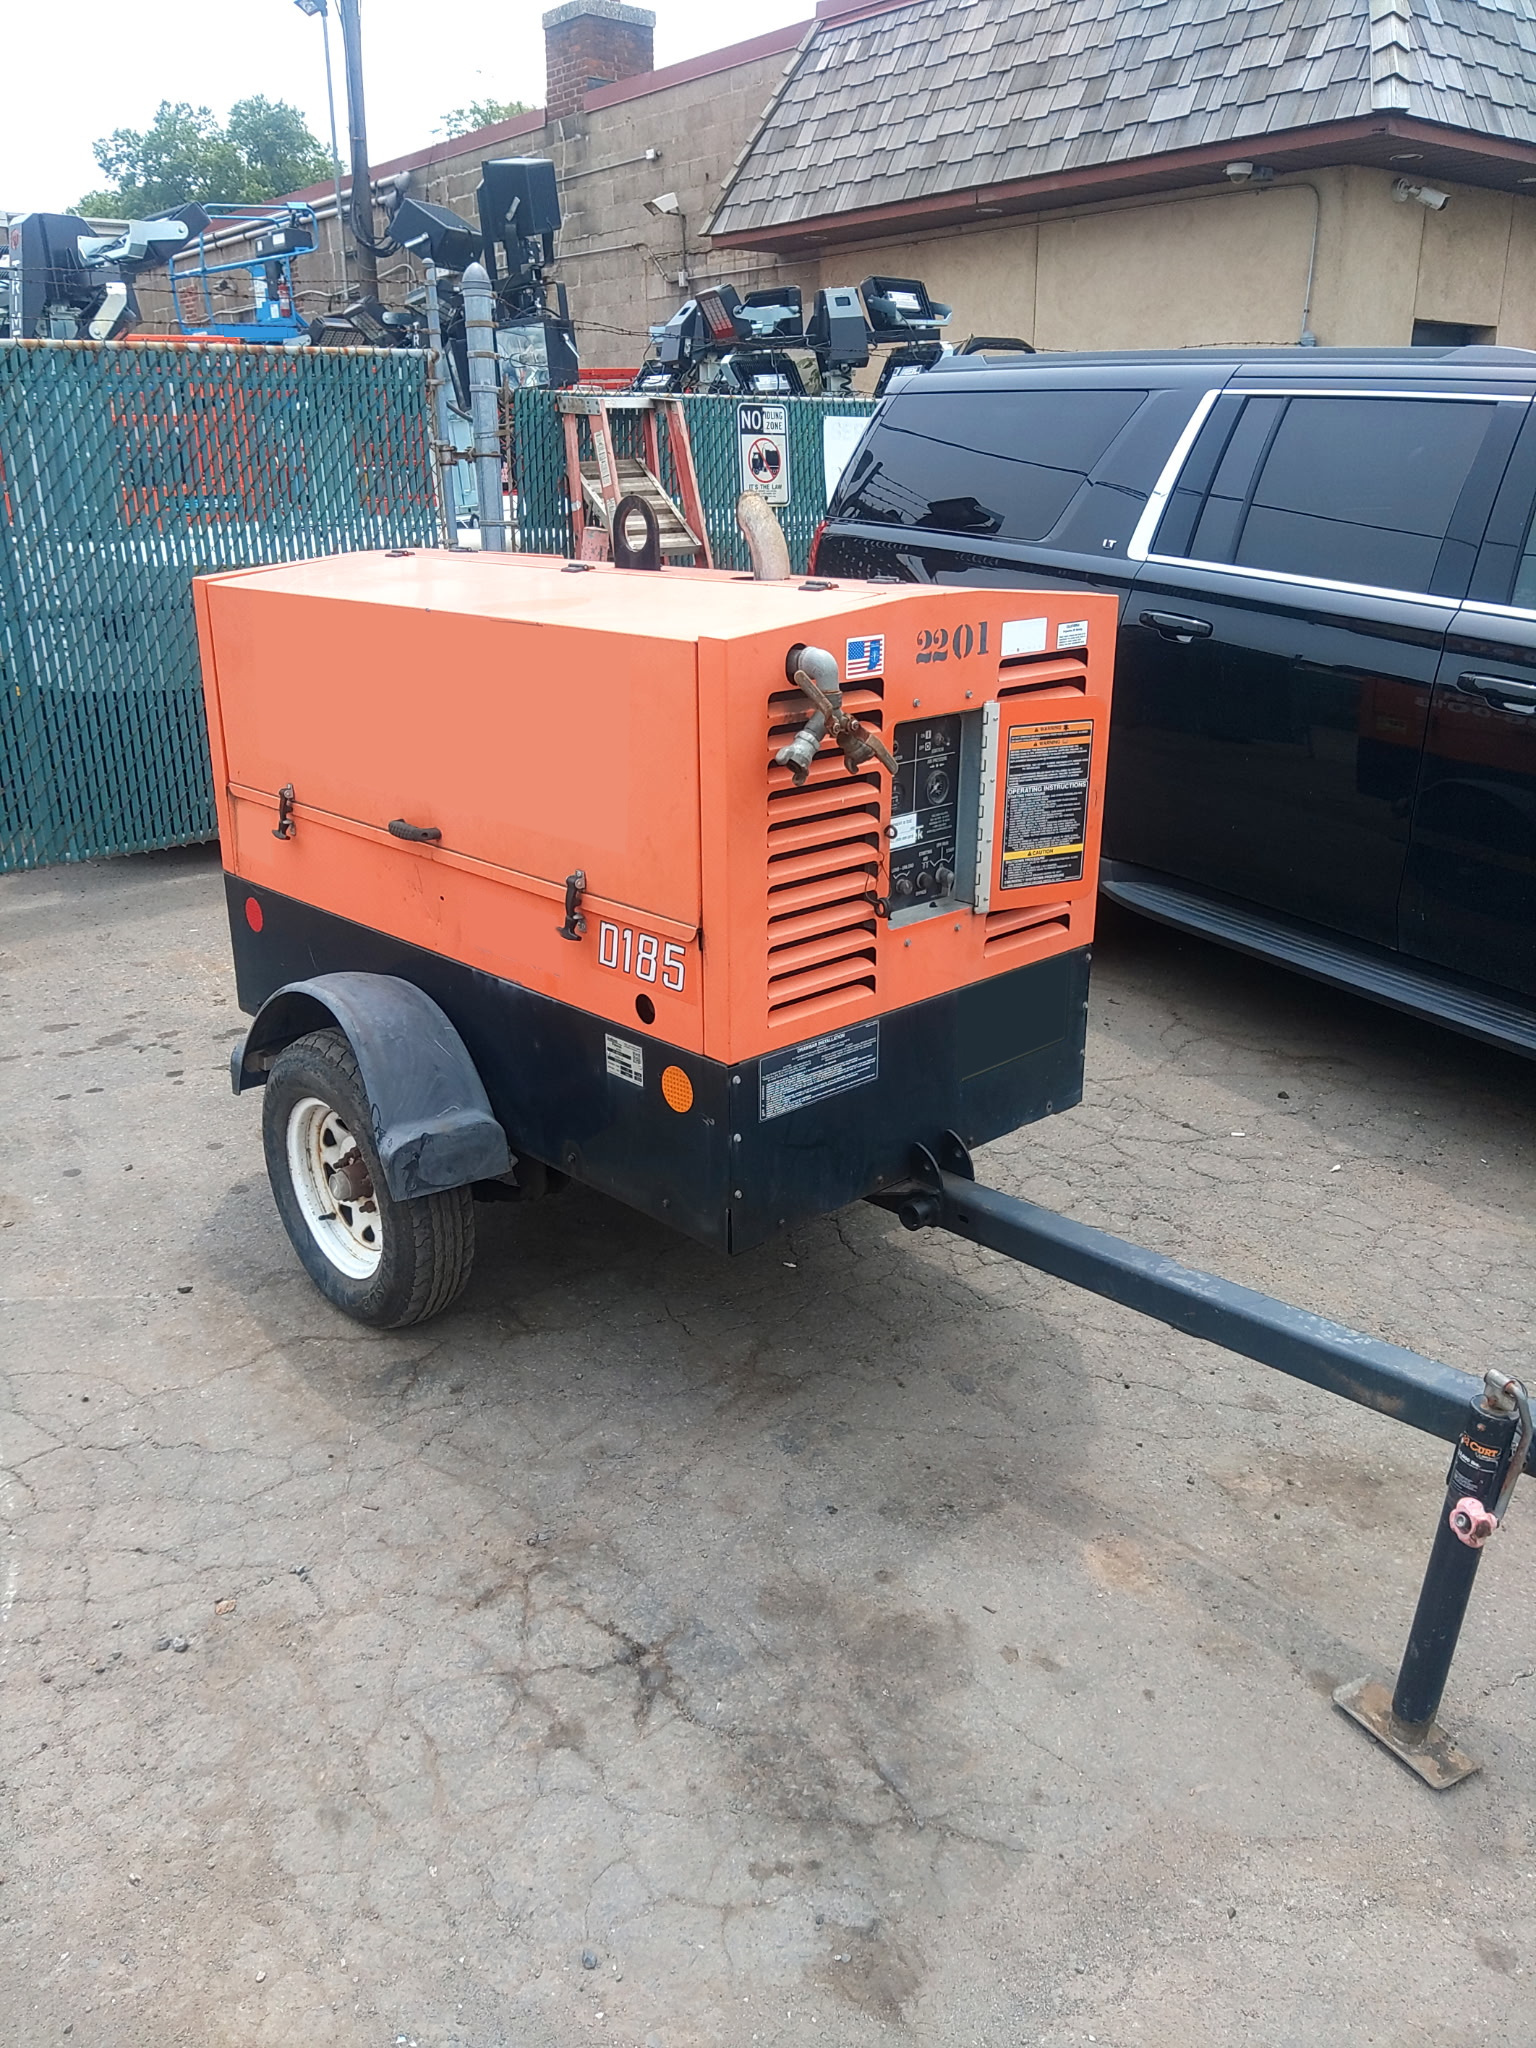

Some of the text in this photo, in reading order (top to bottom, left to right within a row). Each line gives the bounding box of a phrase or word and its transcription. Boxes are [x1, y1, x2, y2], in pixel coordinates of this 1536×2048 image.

[741, 410, 762, 430] NO
[764, 411, 783, 420] IDLING
[766, 421, 783, 430] ZONE
[1102, 539, 1117, 549] LT
[916, 621, 989, 665] 2201
[1007, 782, 1087, 795] OPERATING INSTRUCTIONS
[598, 920, 686, 992] D185
[1470, 1441, 1499, 1457] CURT
